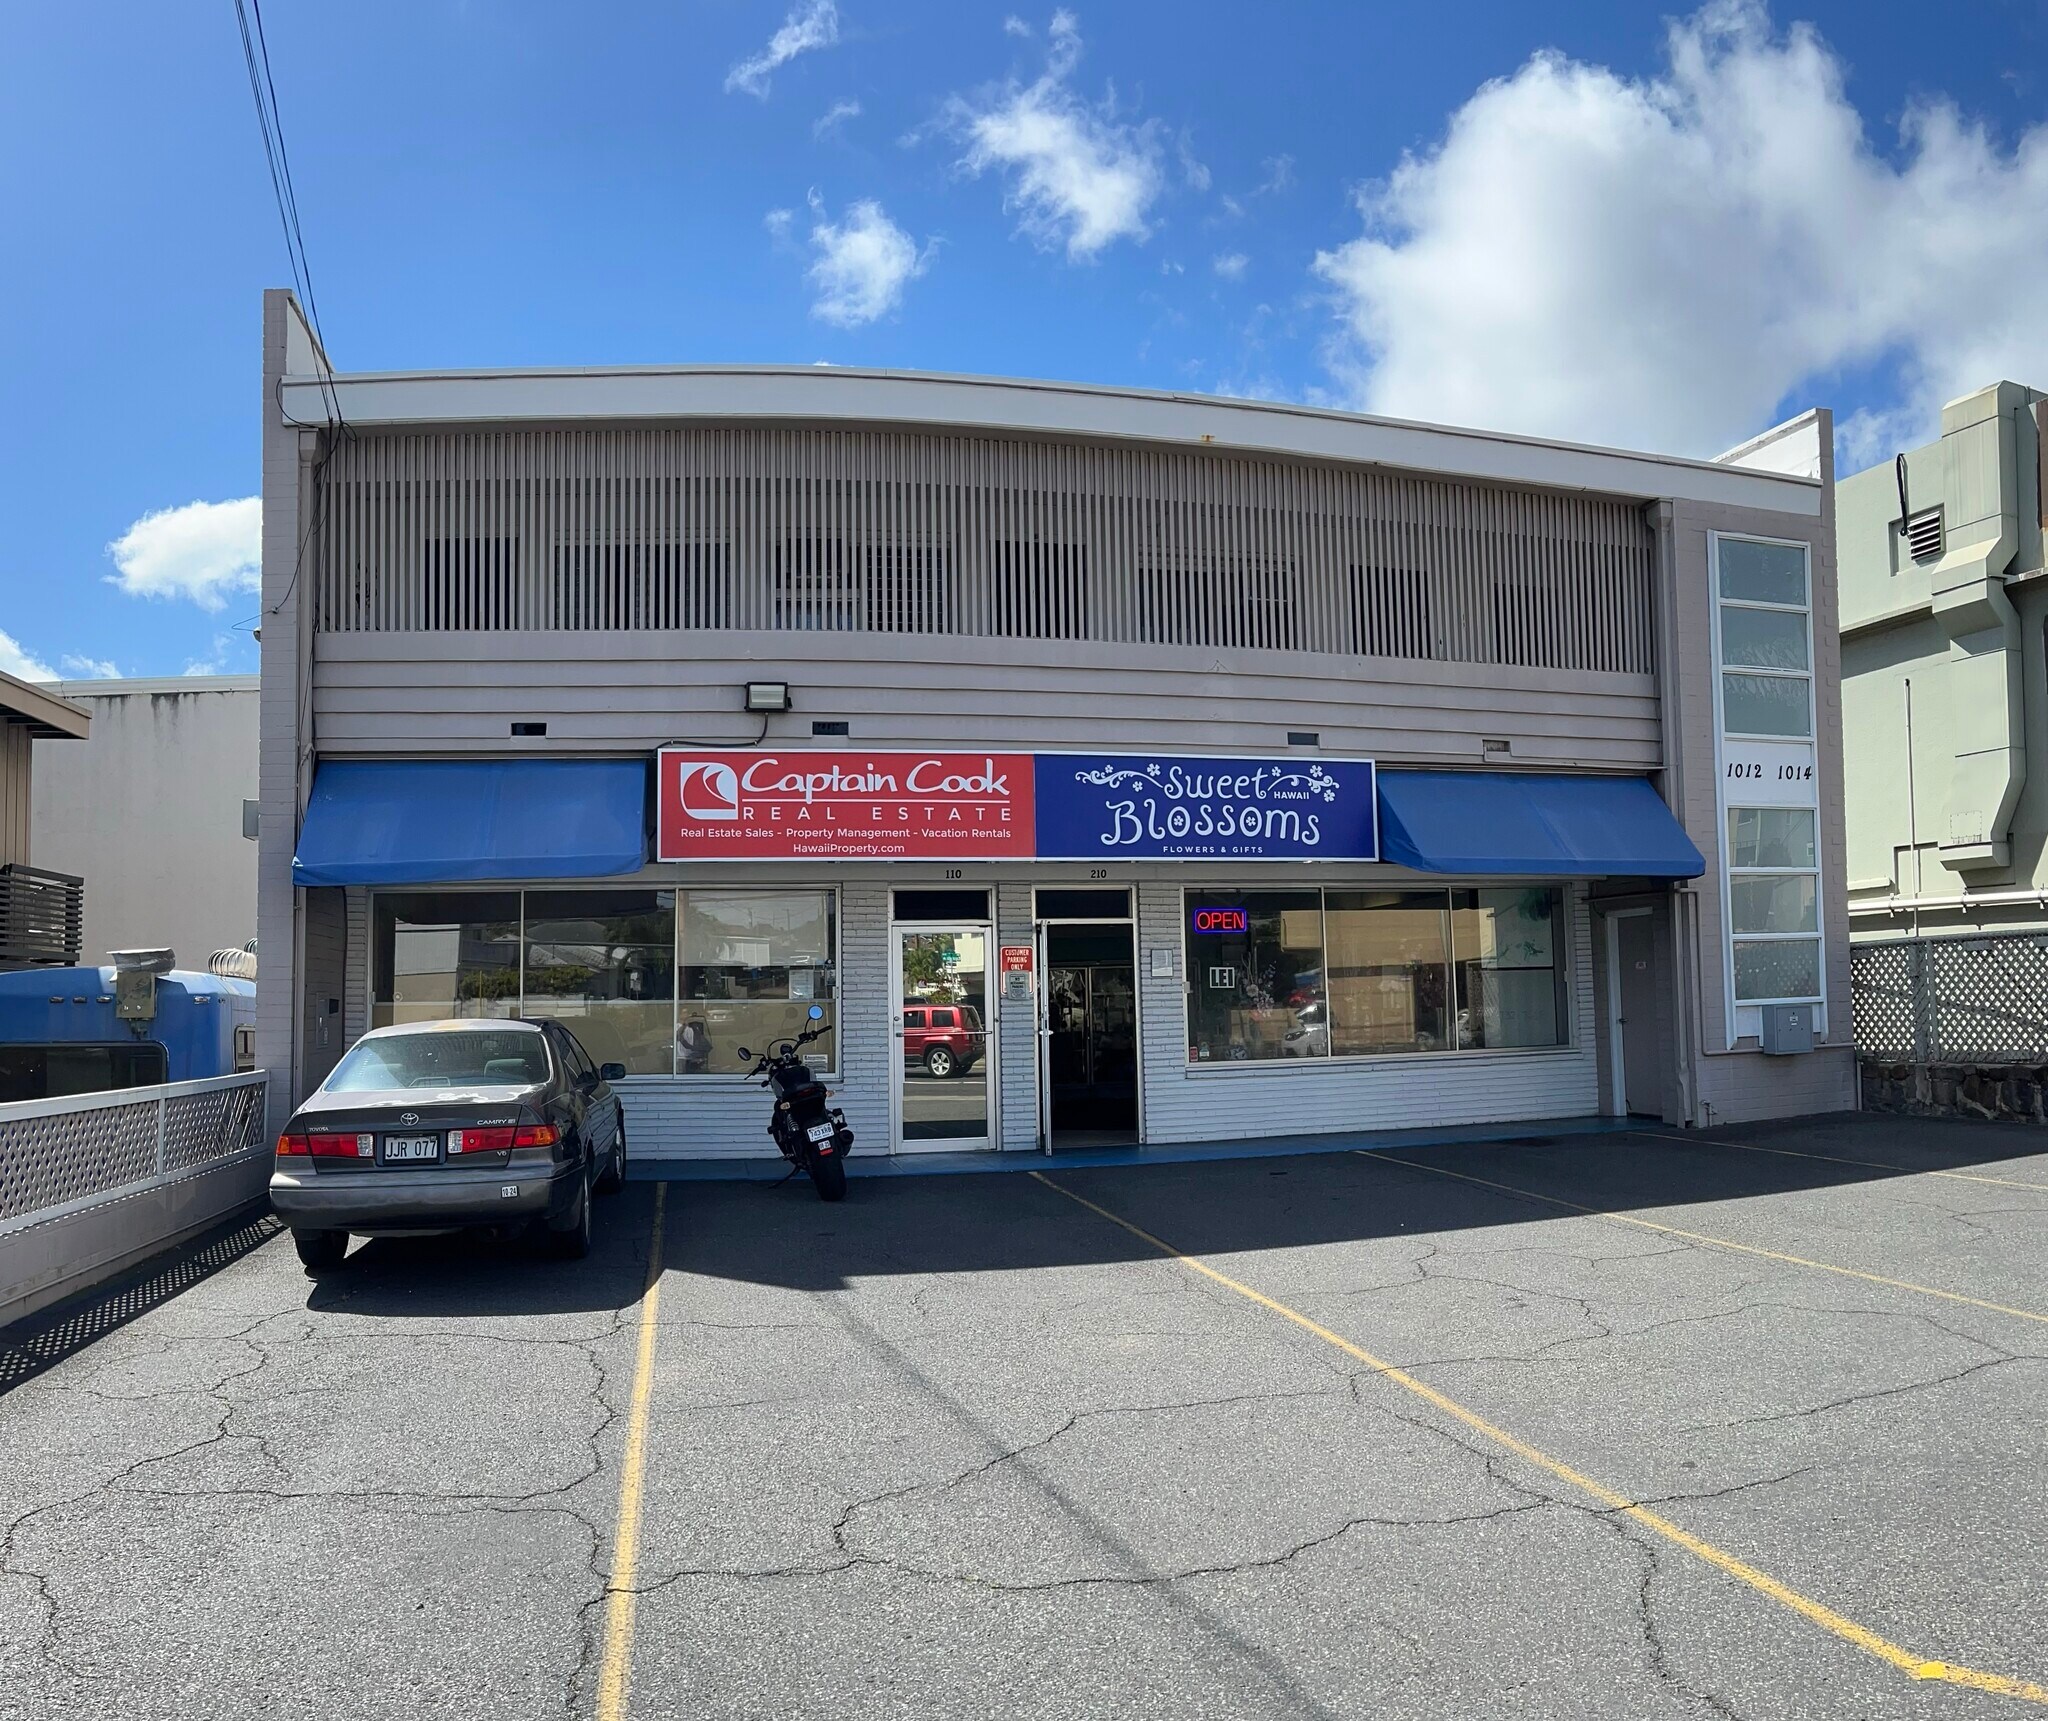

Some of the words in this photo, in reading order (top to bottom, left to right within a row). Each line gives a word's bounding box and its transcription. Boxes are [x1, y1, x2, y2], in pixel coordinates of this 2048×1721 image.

[1727, 763, 1762, 779] 1012
[1778, 765, 1812, 780] 1014
[741, 758, 898, 805] Captain
[906, 758, 1010, 796] Cook
[1162, 765, 1269, 800] Sweet
[1273, 791, 1310, 800] HAWAII
[743, 806, 837, 821] REAL
[872, 806, 1012, 821] ESTATE
[1099, 797, 1321, 846] Blossoms
[681, 827, 704, 838] Real
[707, 827, 743, 838] Estate
[745, 827, 774, 838] Sales
[786, 827, 834, 840] Property
[836, 827, 911, 840] Management
[921, 828, 969, 838] Vacation
[971, 828, 1012, 839] Rentals
[793, 843, 905, 856] HawaiiProperty.com
[1162, 845, 1216, 854] FLOWERS
[1220, 846, 1227, 854] &
[1232, 846, 1264, 854] GIFTS
[945, 869, 962, 879] 110
[1090, 869, 1107, 879] 210
[1197, 912, 1245, 930] OPEN
[1210, 968, 1235, 987] LEI
[386, 1141, 408, 1158] JJR
[414, 1140, 437, 1157] 077
